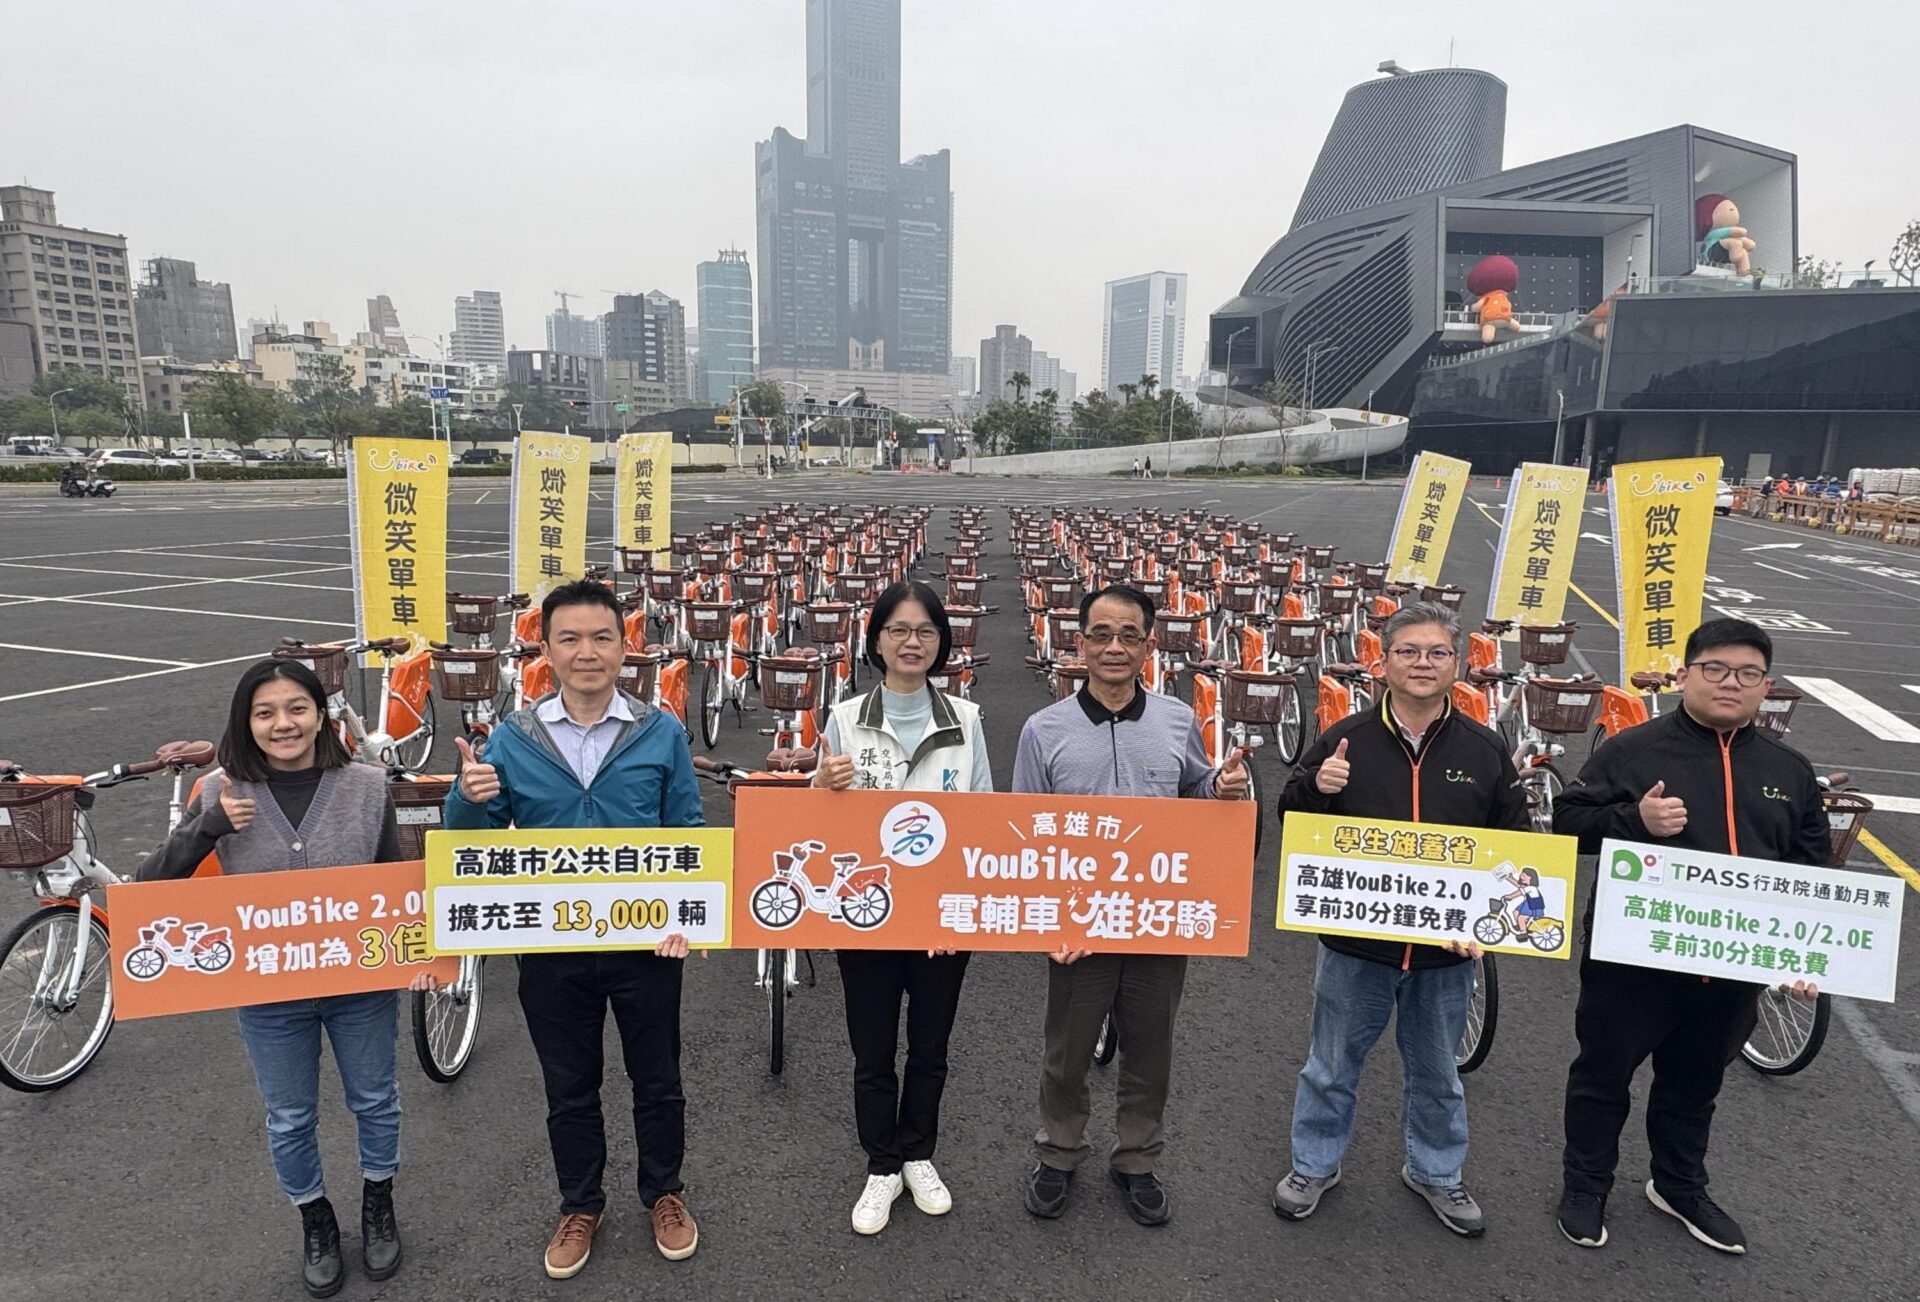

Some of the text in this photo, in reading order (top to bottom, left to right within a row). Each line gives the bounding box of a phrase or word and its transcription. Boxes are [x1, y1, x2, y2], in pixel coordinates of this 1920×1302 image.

[383, 481, 419, 626] 微笑單車
[1643, 503, 1681, 650] 微笑單車
[1032, 811, 1122, 840] 高雄市
[1333, 825, 1477, 865] 學生雄蓋省
[453, 843, 703, 879] 高雄市公共自行車
[962, 846, 1189, 884] YouBike 2.0E
[1296, 863, 1473, 902] 高雄YouBike 2.0
[235, 889, 427, 930] YouBike 2.0
[448, 897, 708, 937] 擴充至 13,000 輛
[938, 893, 1062, 935] 電輔車
[1294, 893, 1467, 934] 享前30分鐘免費
[1624, 894, 1874, 951] 高雄YouBike 2.0/2.0E
[244, 920, 433, 976] 增加為3倍
[1648, 928, 1829, 977] 享前30分鐘免費
